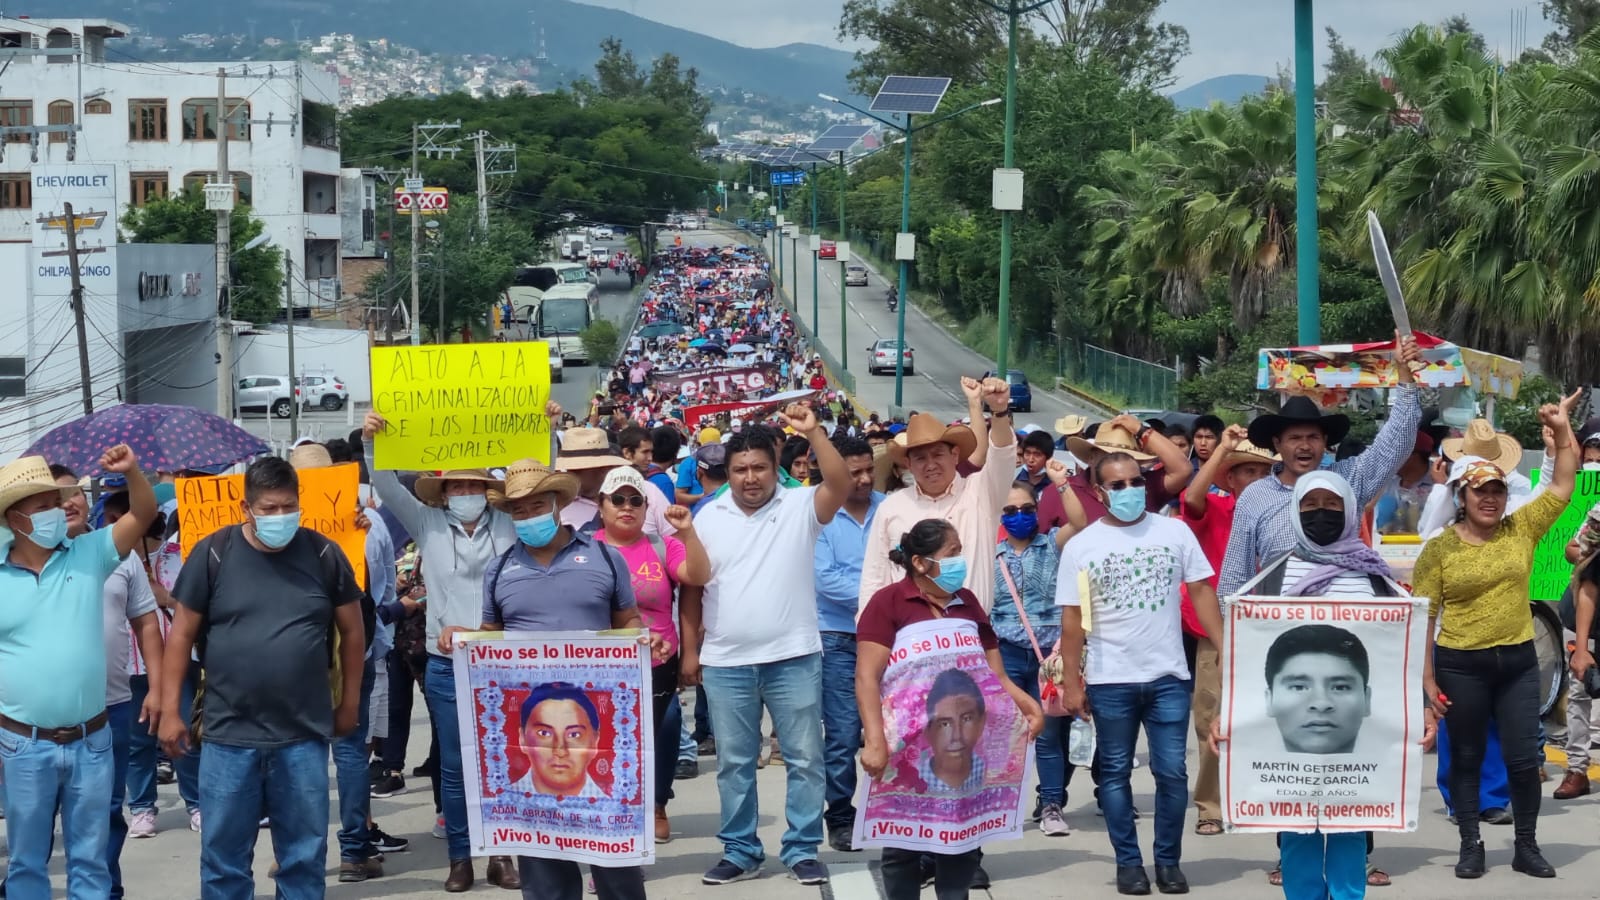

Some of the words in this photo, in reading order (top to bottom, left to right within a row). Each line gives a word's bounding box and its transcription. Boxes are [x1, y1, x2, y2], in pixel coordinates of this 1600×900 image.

[36, 175, 108, 187] CHEVROLET
[38, 265, 111, 277] CHILPACINGO
[390, 349, 448, 382] ALTO
[468, 350, 484, 379] A
[499, 348, 526, 380] LA
[376, 384, 539, 415] CRIMINALIZACION
[384, 419, 411, 438] DE
[429, 414, 462, 437] LOS
[472, 412, 549, 435] LUCHADORES
[421, 440, 507, 465] SOCIALES
[183, 477, 241, 504] ALTO
[324, 489, 342, 517] Y
[182, 504, 242, 530] AMEN
[302, 518, 345, 534] CION
[637, 561, 663, 581] 43
[1237, 603, 1281, 620] ¡Vivo
[1286, 608, 1305, 620] se
[1310, 604, 1326, 620] lo
[1331, 604, 1406, 622] llevaron!
[471, 645, 513, 664] ¡Vivo
[518, 647, 538, 659] se
[543, 644, 559, 659] lo
[564, 643, 638, 659] llevaron!
[912, 640, 931, 654] se
[935, 634, 950, 649] lo
[1252, 761, 1300, 772] MARTÍN
[1303, 763, 1378, 773] GETSEMANY
[1260, 773, 1320, 785] SÁNCHEZ
[1323, 775, 1370, 785] GARCÍA
[1327, 788, 1358, 797] AÑOS
[570, 813, 582, 822] DE
[589, 815, 602, 824] LA
[608, 814, 634, 825] CRUZ
[1235, 801, 1264, 818] ¡Con
[1269, 802, 1302, 817] VIDA
[1307, 802, 1319, 817] lo
[1323, 802, 1395, 820] queremos!
[872, 821, 913, 838] ¡Vivo
[919, 824, 933, 838] lo
[940, 813, 1007, 844] queremos!
[493, 828, 532, 846] ¡Vivo
[537, 831, 550, 845] lo
[555, 837, 634, 854] queremos!
